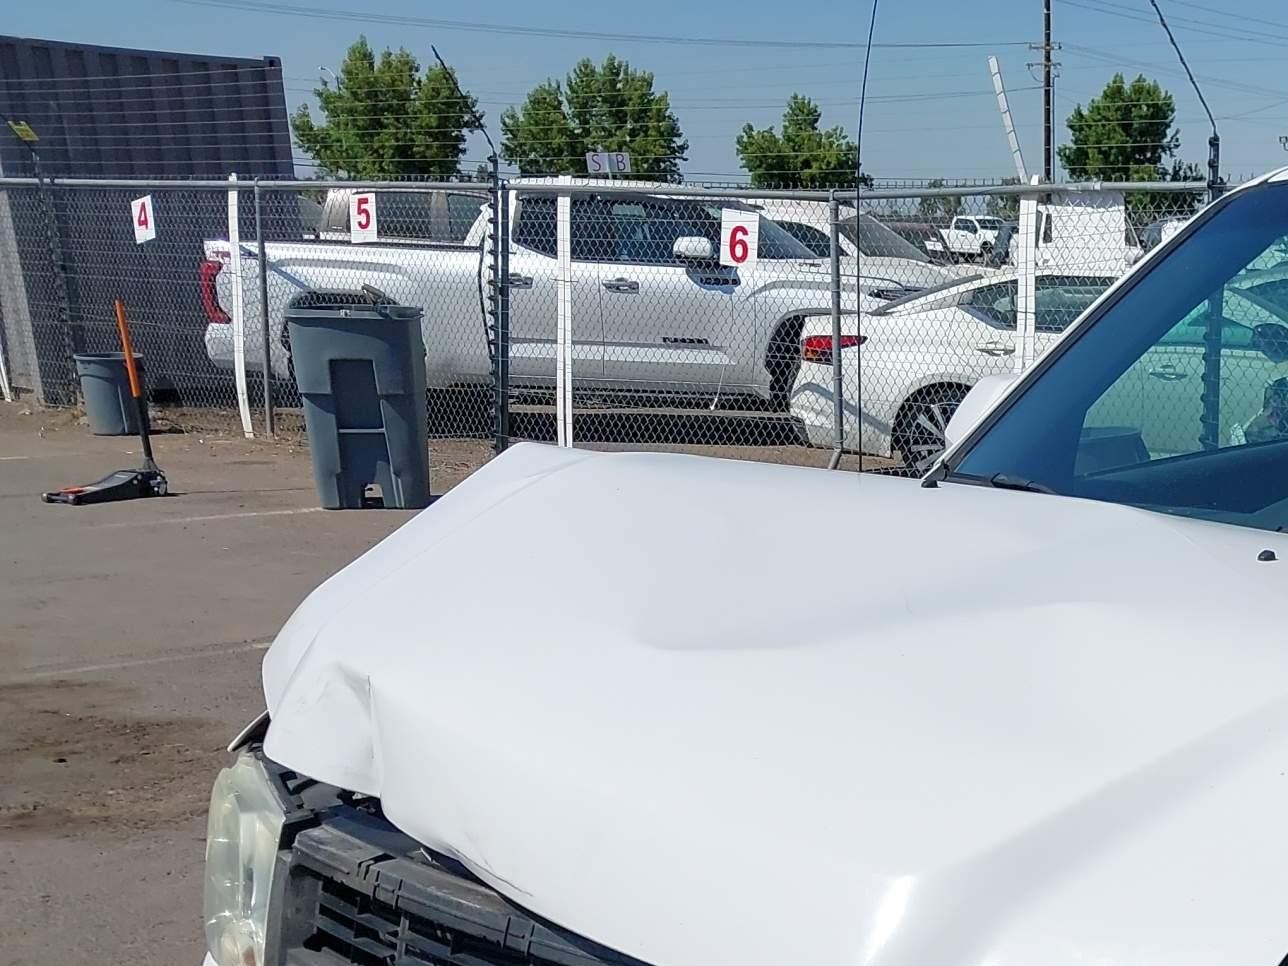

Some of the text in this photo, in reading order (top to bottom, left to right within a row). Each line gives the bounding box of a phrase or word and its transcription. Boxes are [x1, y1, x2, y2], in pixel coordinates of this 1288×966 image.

[137, 201, 149, 230] 4
[356, 197, 371, 230] 5
[729, 225, 749, 264] 6
